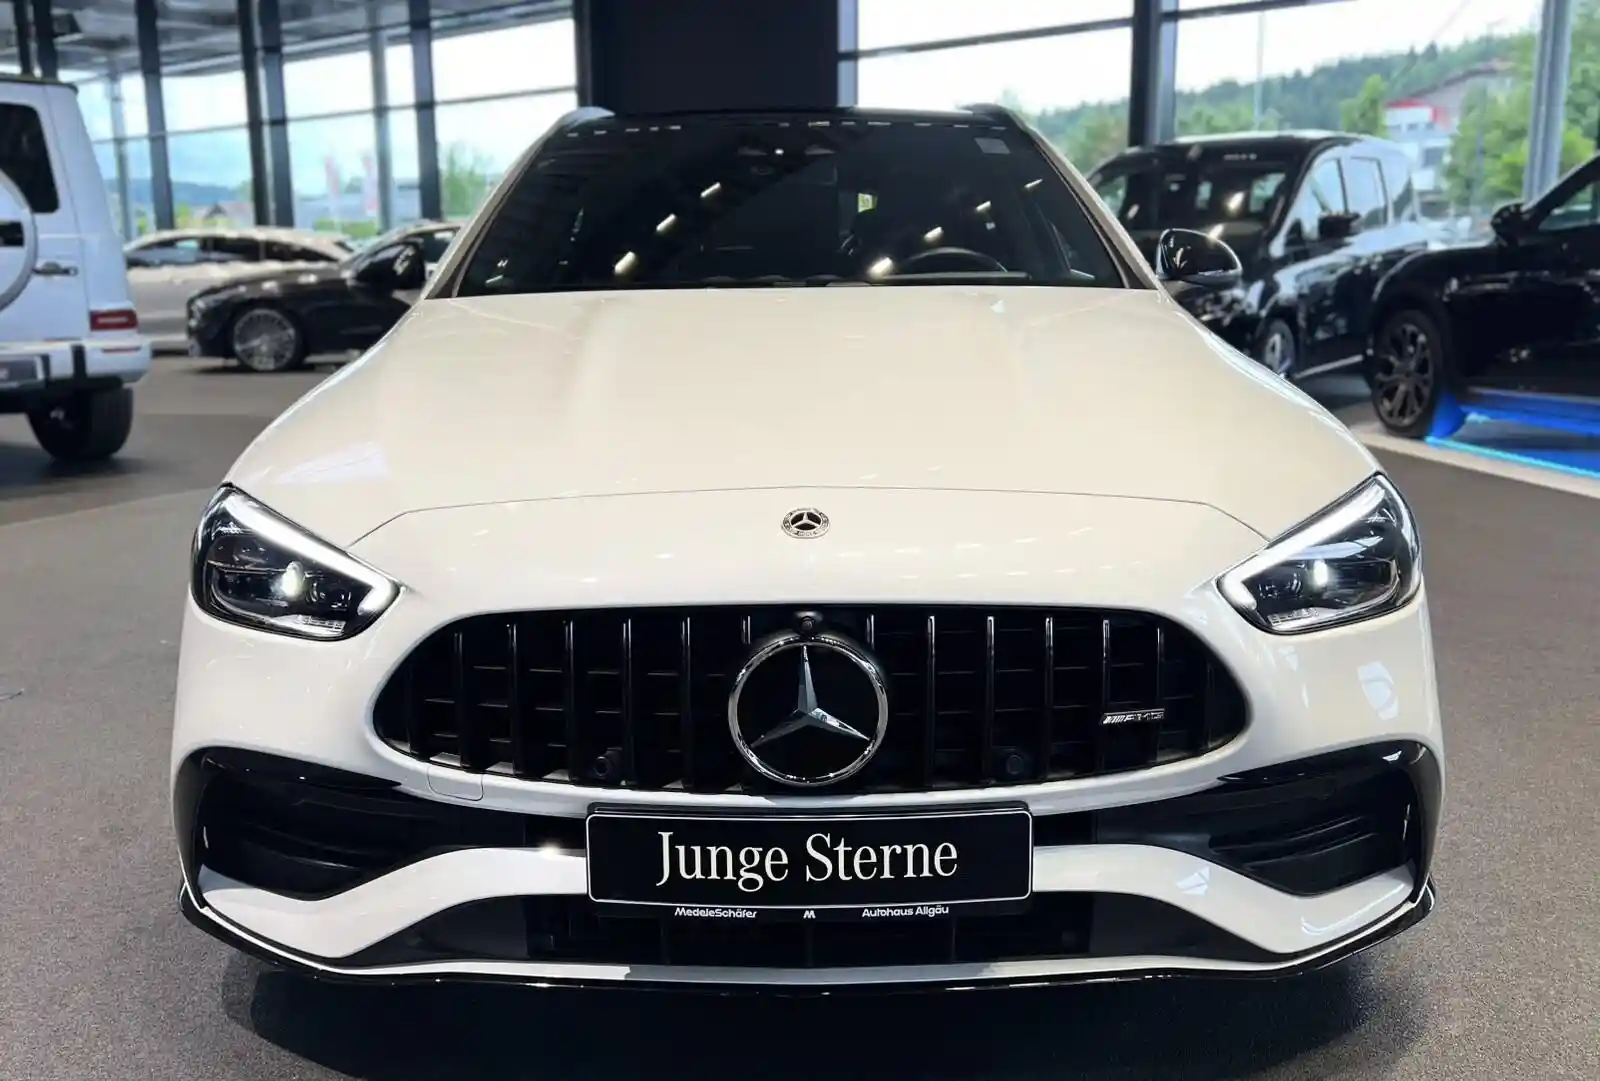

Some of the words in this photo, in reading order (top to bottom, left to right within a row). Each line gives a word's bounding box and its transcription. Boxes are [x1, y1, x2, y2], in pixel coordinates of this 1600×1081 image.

[656, 831, 789, 893] Junge
[805, 832, 958, 882] Sterne
[674, 907, 757, 918] MedeleSchäfer
[862, 906, 914, 917] Autohaus
[915, 903, 949, 917] Allgäu
